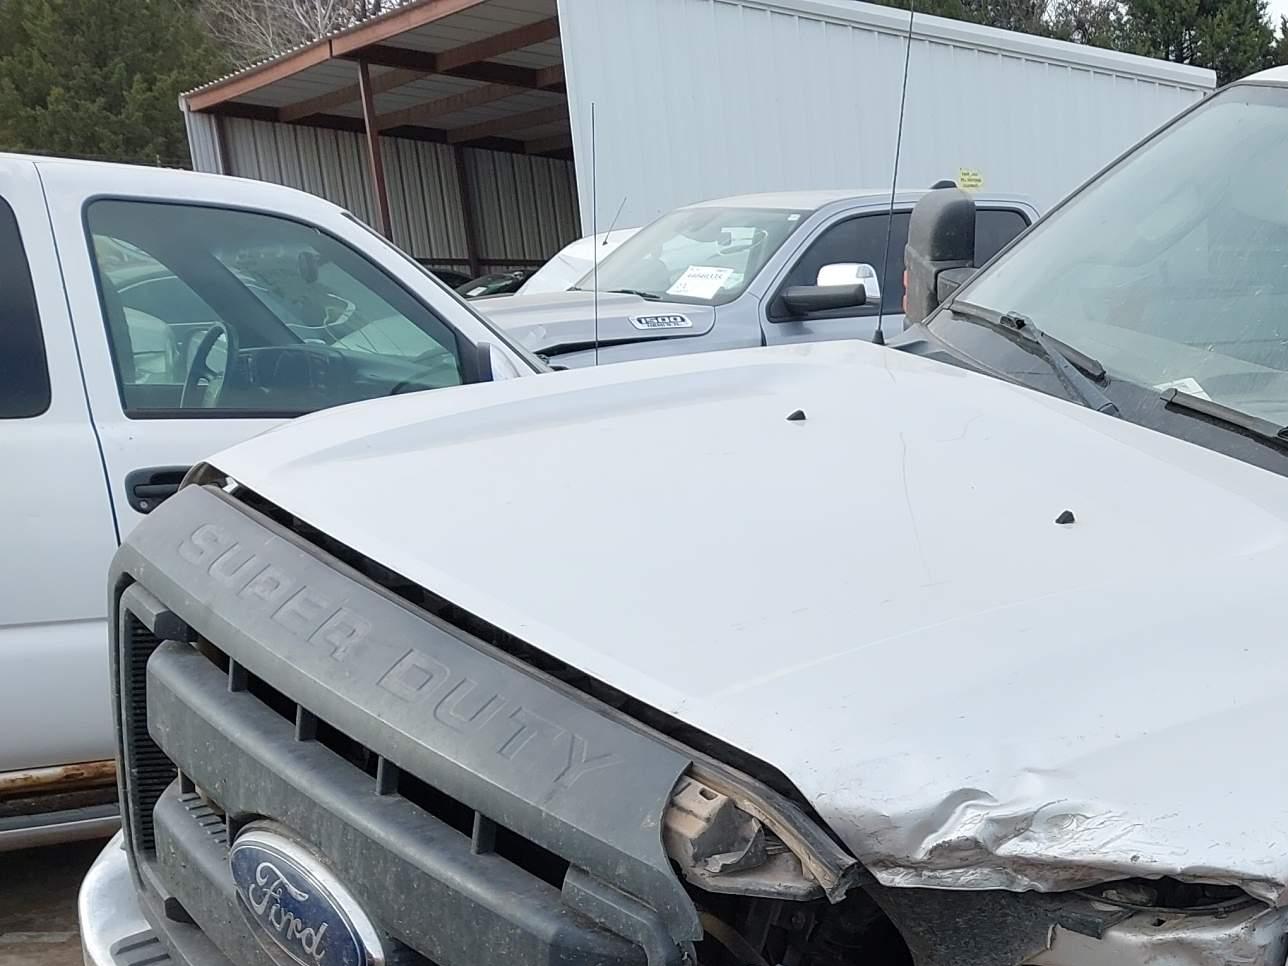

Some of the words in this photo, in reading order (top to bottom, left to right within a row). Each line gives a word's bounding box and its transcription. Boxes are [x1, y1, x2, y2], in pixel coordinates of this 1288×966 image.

[641, 316, 683, 325] 1500
[175, 521, 373, 663] SUPER
[375, 646, 624, 806] DUTY
[249, 861, 329, 961] Ford
